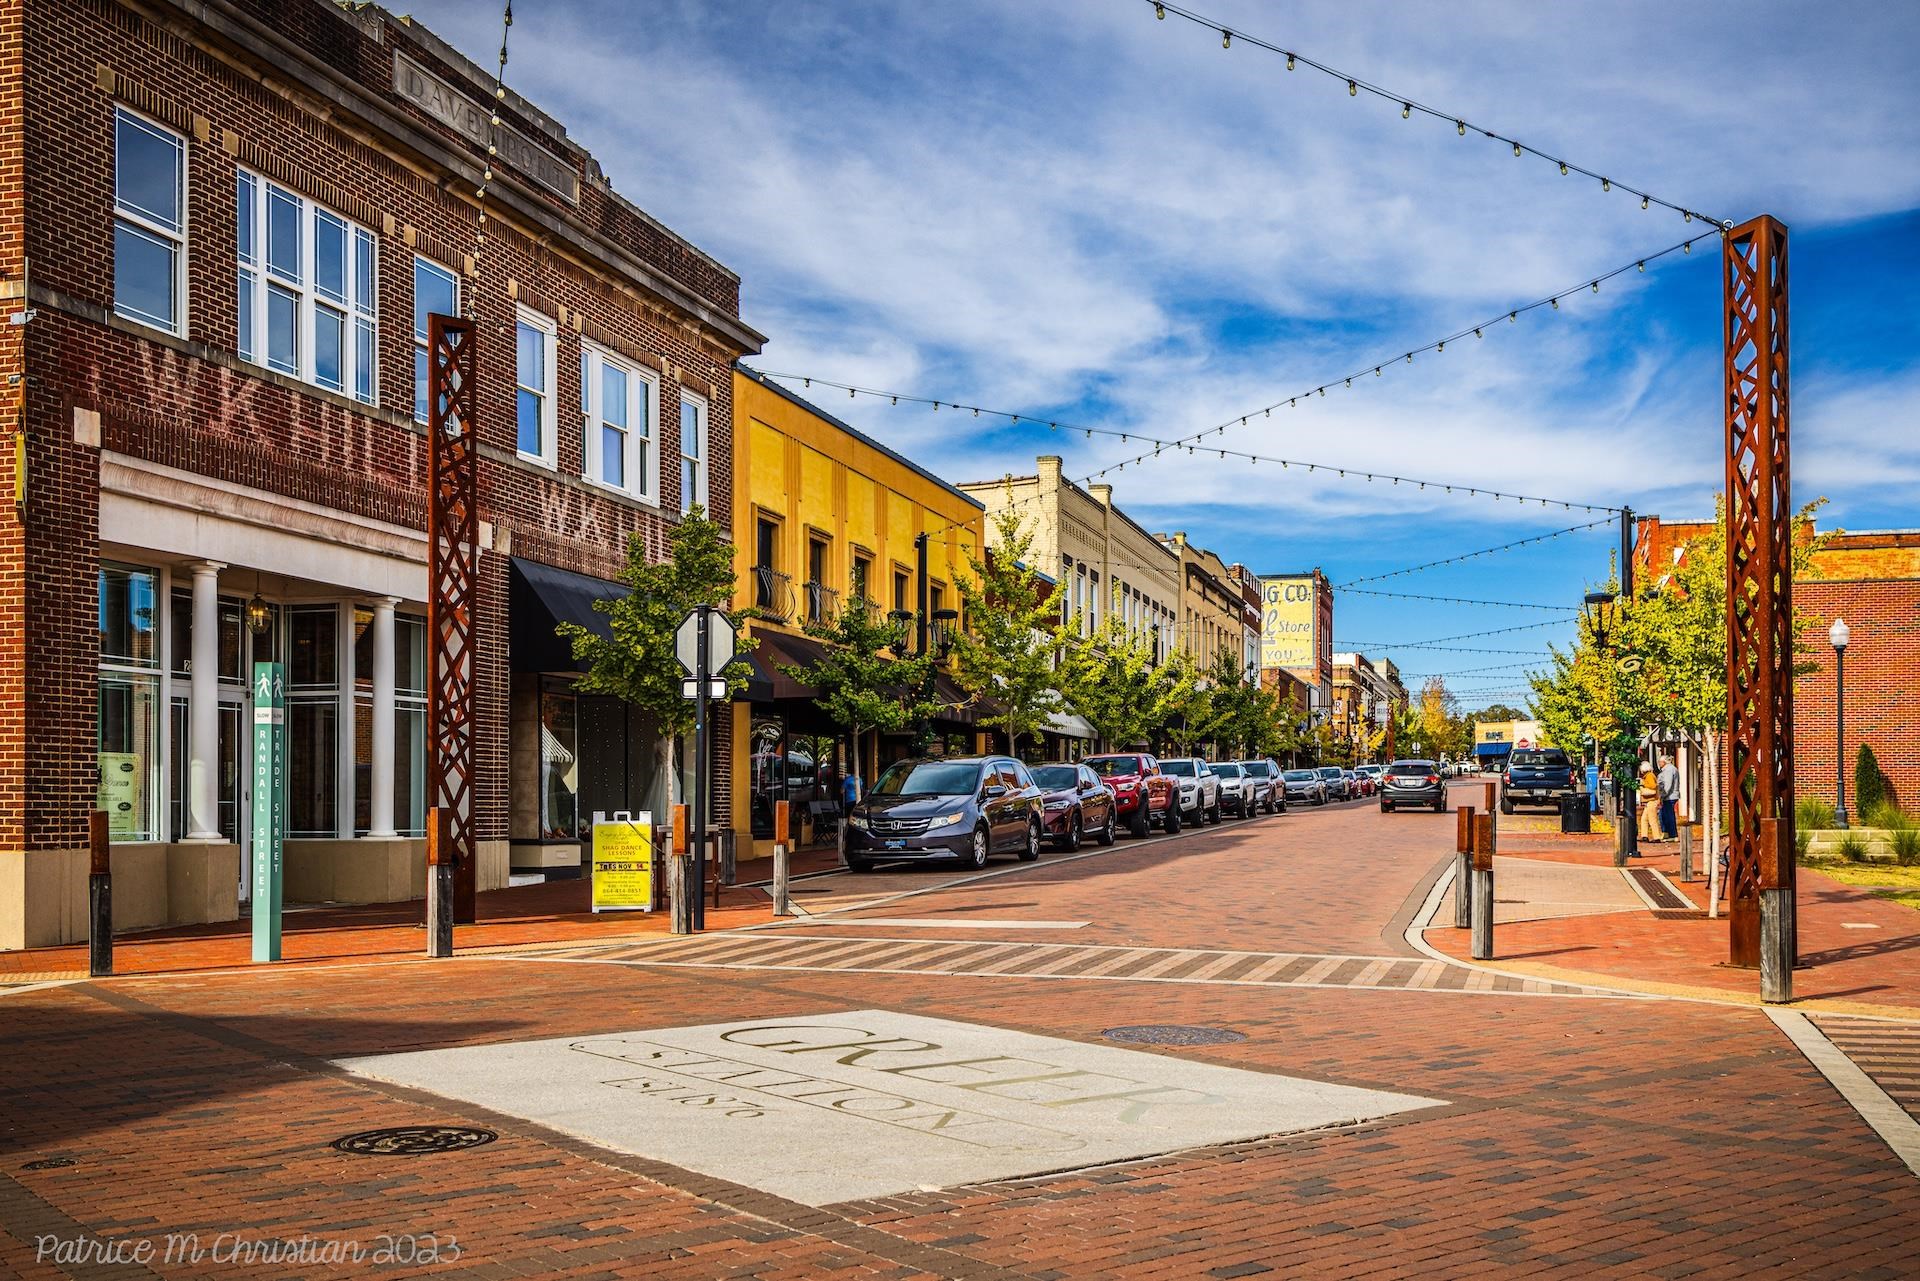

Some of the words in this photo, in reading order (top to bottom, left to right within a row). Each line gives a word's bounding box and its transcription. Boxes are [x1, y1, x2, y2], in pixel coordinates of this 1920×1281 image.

[407, 70, 566, 188] DAVENPORT
[1278, 621, 1310, 633] Store
[258, 730, 267, 812] RANDALL
[257, 827, 266, 897] STREET
[618, 1050, 997, 1132] STATION
[719, 1025, 1226, 1129] GREER
